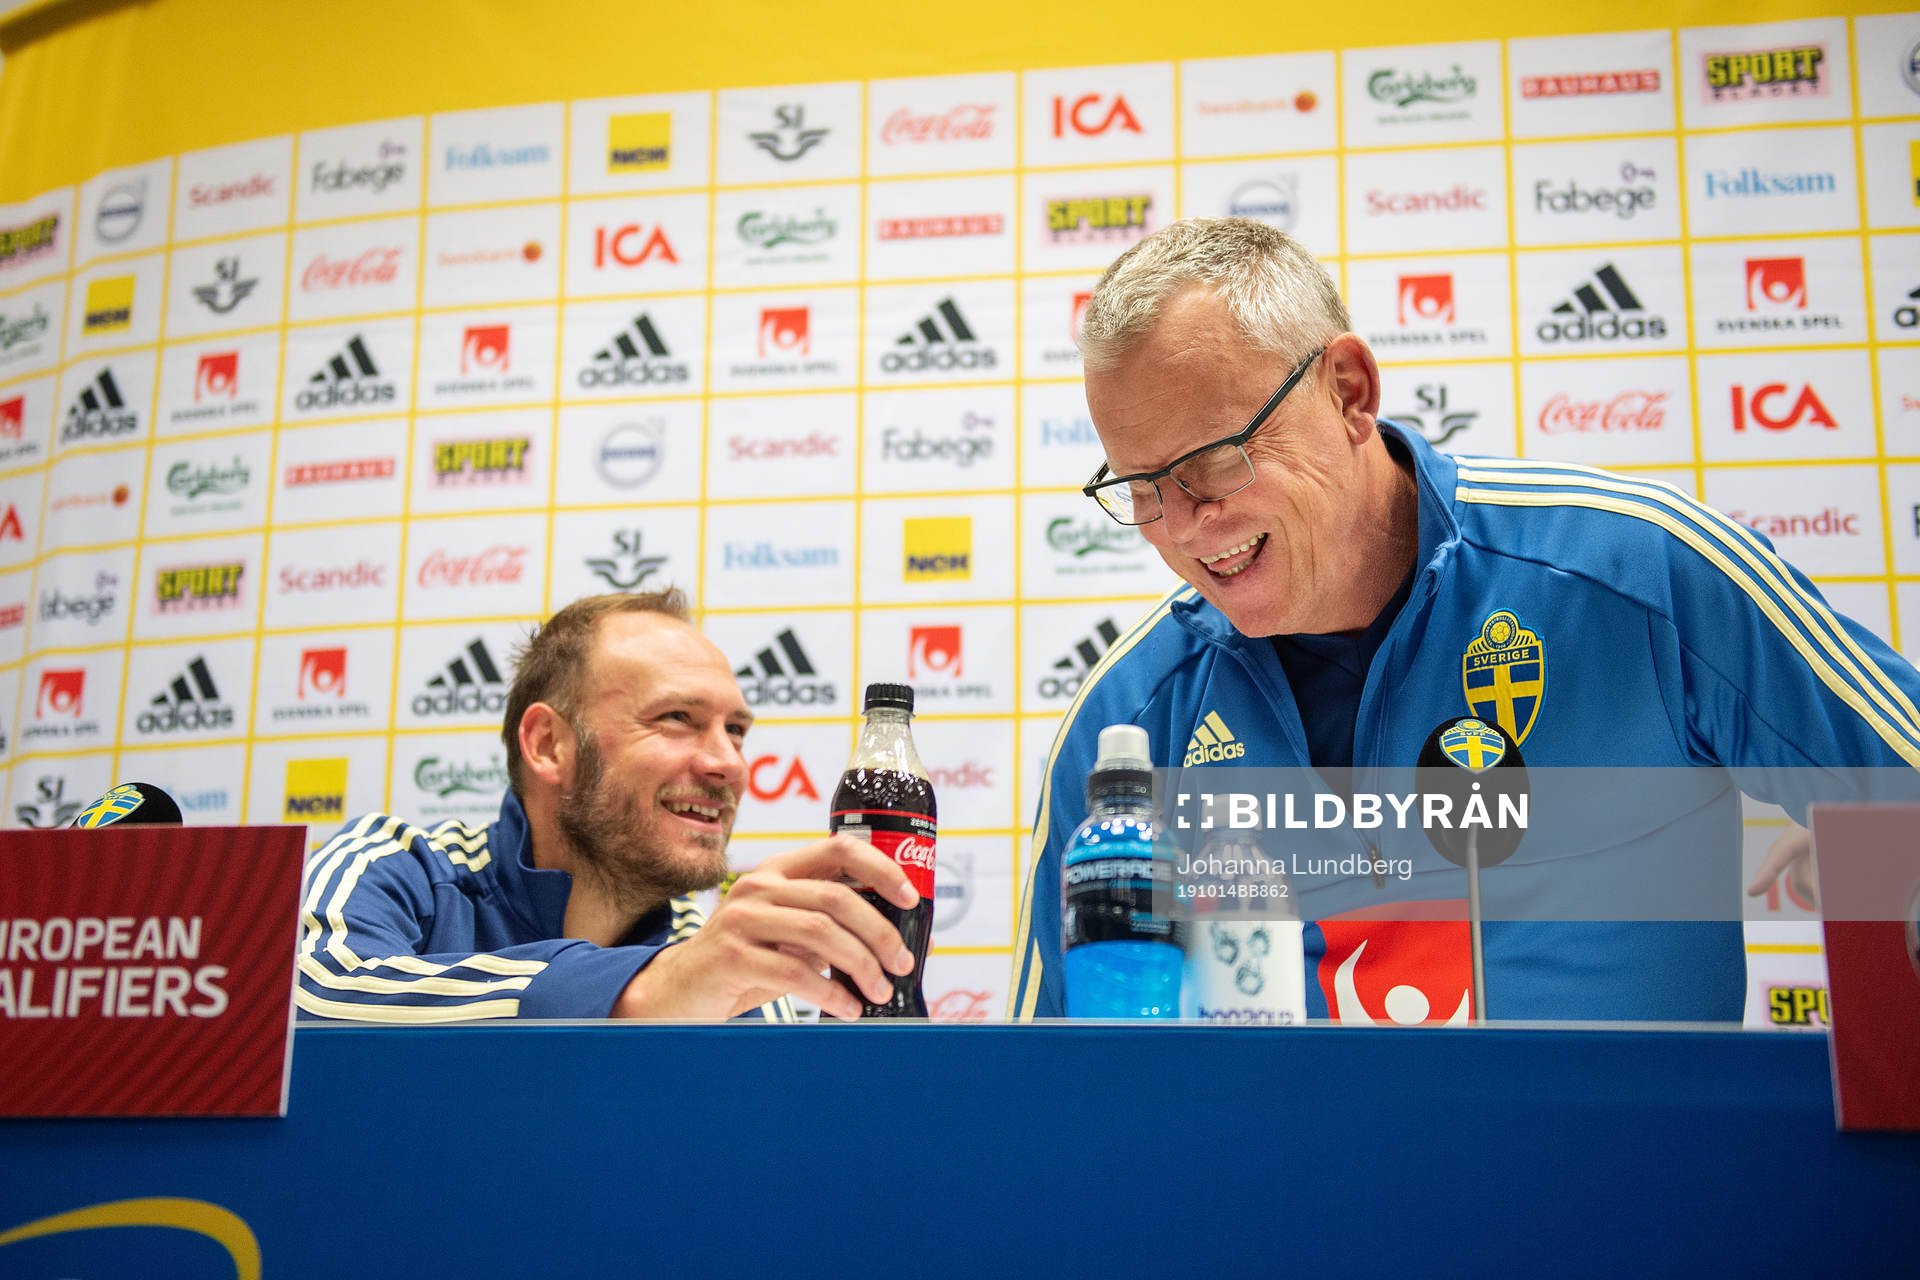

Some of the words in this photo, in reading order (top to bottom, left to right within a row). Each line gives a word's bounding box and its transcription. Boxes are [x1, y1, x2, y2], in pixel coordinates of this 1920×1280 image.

[1706, 48, 1822, 87] SPORT
[1367, 65, 1476, 107] Carlsberg
[1523, 71, 1659, 97] BAUHAUS
[774, 105, 803, 128] SJ
[1053, 93, 1143, 137] ICA
[445, 145, 549, 171] Folksam
[190, 174, 276, 207] Scandic
[311, 158, 404, 193] Fabege
[1705, 167, 1835, 198] Folksam
[1047, 196, 1152, 231] SPORT
[1366, 185, 1487, 216] Scandic
[1535, 178, 1656, 219] Fabege
[594, 224, 680, 269] ICA
[215, 257, 240, 281] SJ
[1537, 313, 1667, 343] adidas
[1716, 319, 1796, 333] SVENSKA
[1802, 315, 1843, 329] SPEL
[578, 360, 690, 389] adidas
[880, 346, 1000, 373] adidas
[295, 380, 396, 412] adidas
[1416, 386, 1447, 412] SJ
[1731, 383, 1839, 432] ICA
[435, 438, 529, 473] SPORT
[729, 433, 839, 461] Scandic
[882, 427, 993, 468] Fabege
[613, 530, 642, 554] SJ
[723, 543, 838, 570] Folksam
[156, 567, 243, 600] SPORT
[280, 564, 385, 593] Scandic
[1473, 648, 1530, 667] SVERIGE
[413, 688, 506, 716] adida
[743, 672, 836, 707] didas
[137, 704, 234, 734] adidas
[1183, 741, 1245, 768] adidas
[748, 755, 820, 800] CA
[934, 761, 994, 788] ndic
[37, 777, 63, 804] SJ
[1066, 859, 1172, 884] OWERADE
[0, 916, 203, 961] ROPEAN
[0, 965, 229, 1018] ALIFIERS
